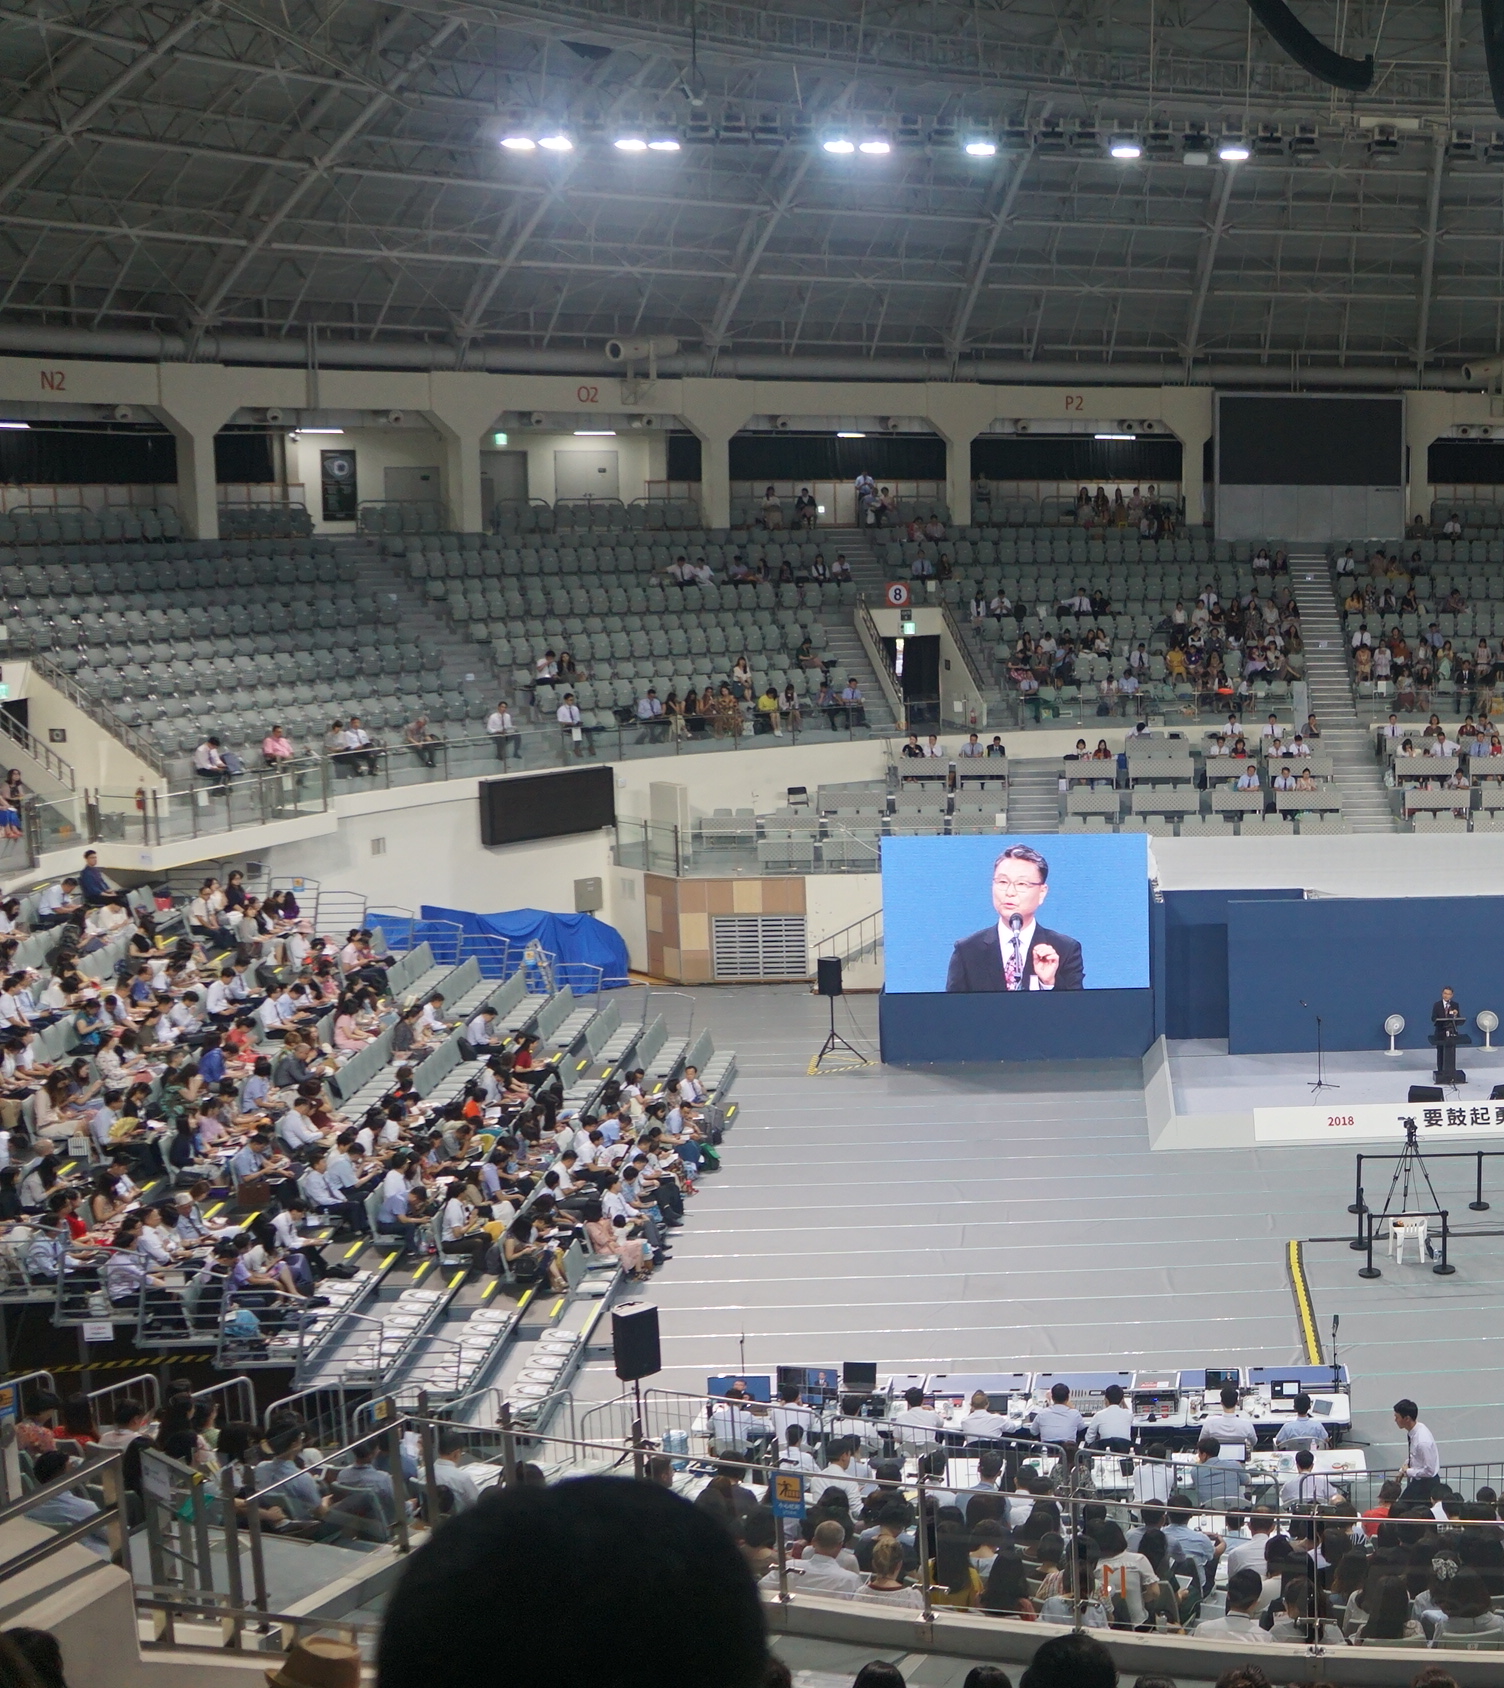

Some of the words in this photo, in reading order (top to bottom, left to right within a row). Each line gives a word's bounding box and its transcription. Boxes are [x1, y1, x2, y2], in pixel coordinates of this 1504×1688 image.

[41, 370, 66, 391] N2
[577, 386, 599, 403] O2
[1065, 395, 1084, 411] P2
[893, 588, 902, 601] 8
[1327, 1116, 1355, 1127] 2018
